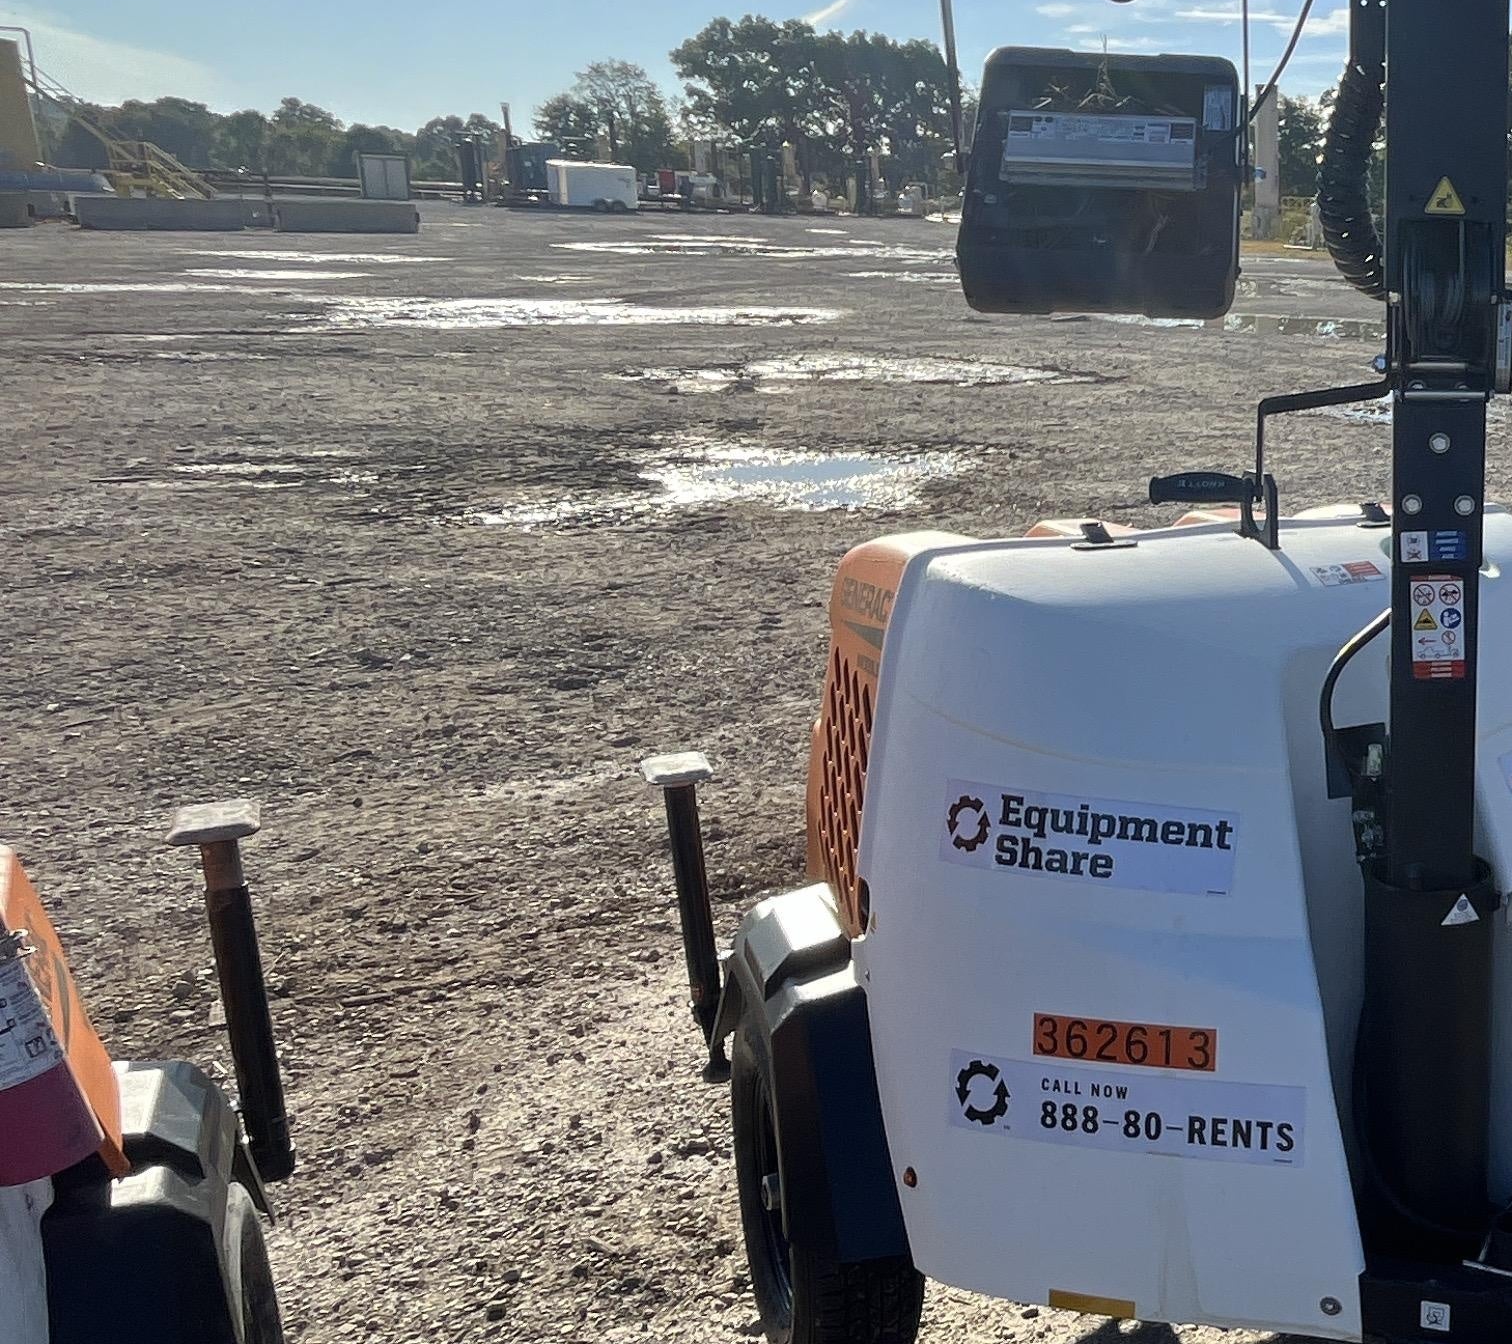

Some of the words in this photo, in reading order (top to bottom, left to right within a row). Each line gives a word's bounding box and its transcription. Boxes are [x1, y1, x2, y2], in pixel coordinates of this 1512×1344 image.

[998, 793, 1233, 851] Equipment
[994, 835, 1114, 880] Share
[1036, 1016, 1212, 1070] 362613
[1041, 1077, 1082, 1096] CALL
[1091, 1082, 1129, 1100] NOW
[1040, 1100, 1295, 1152] 888-80-RENTS
